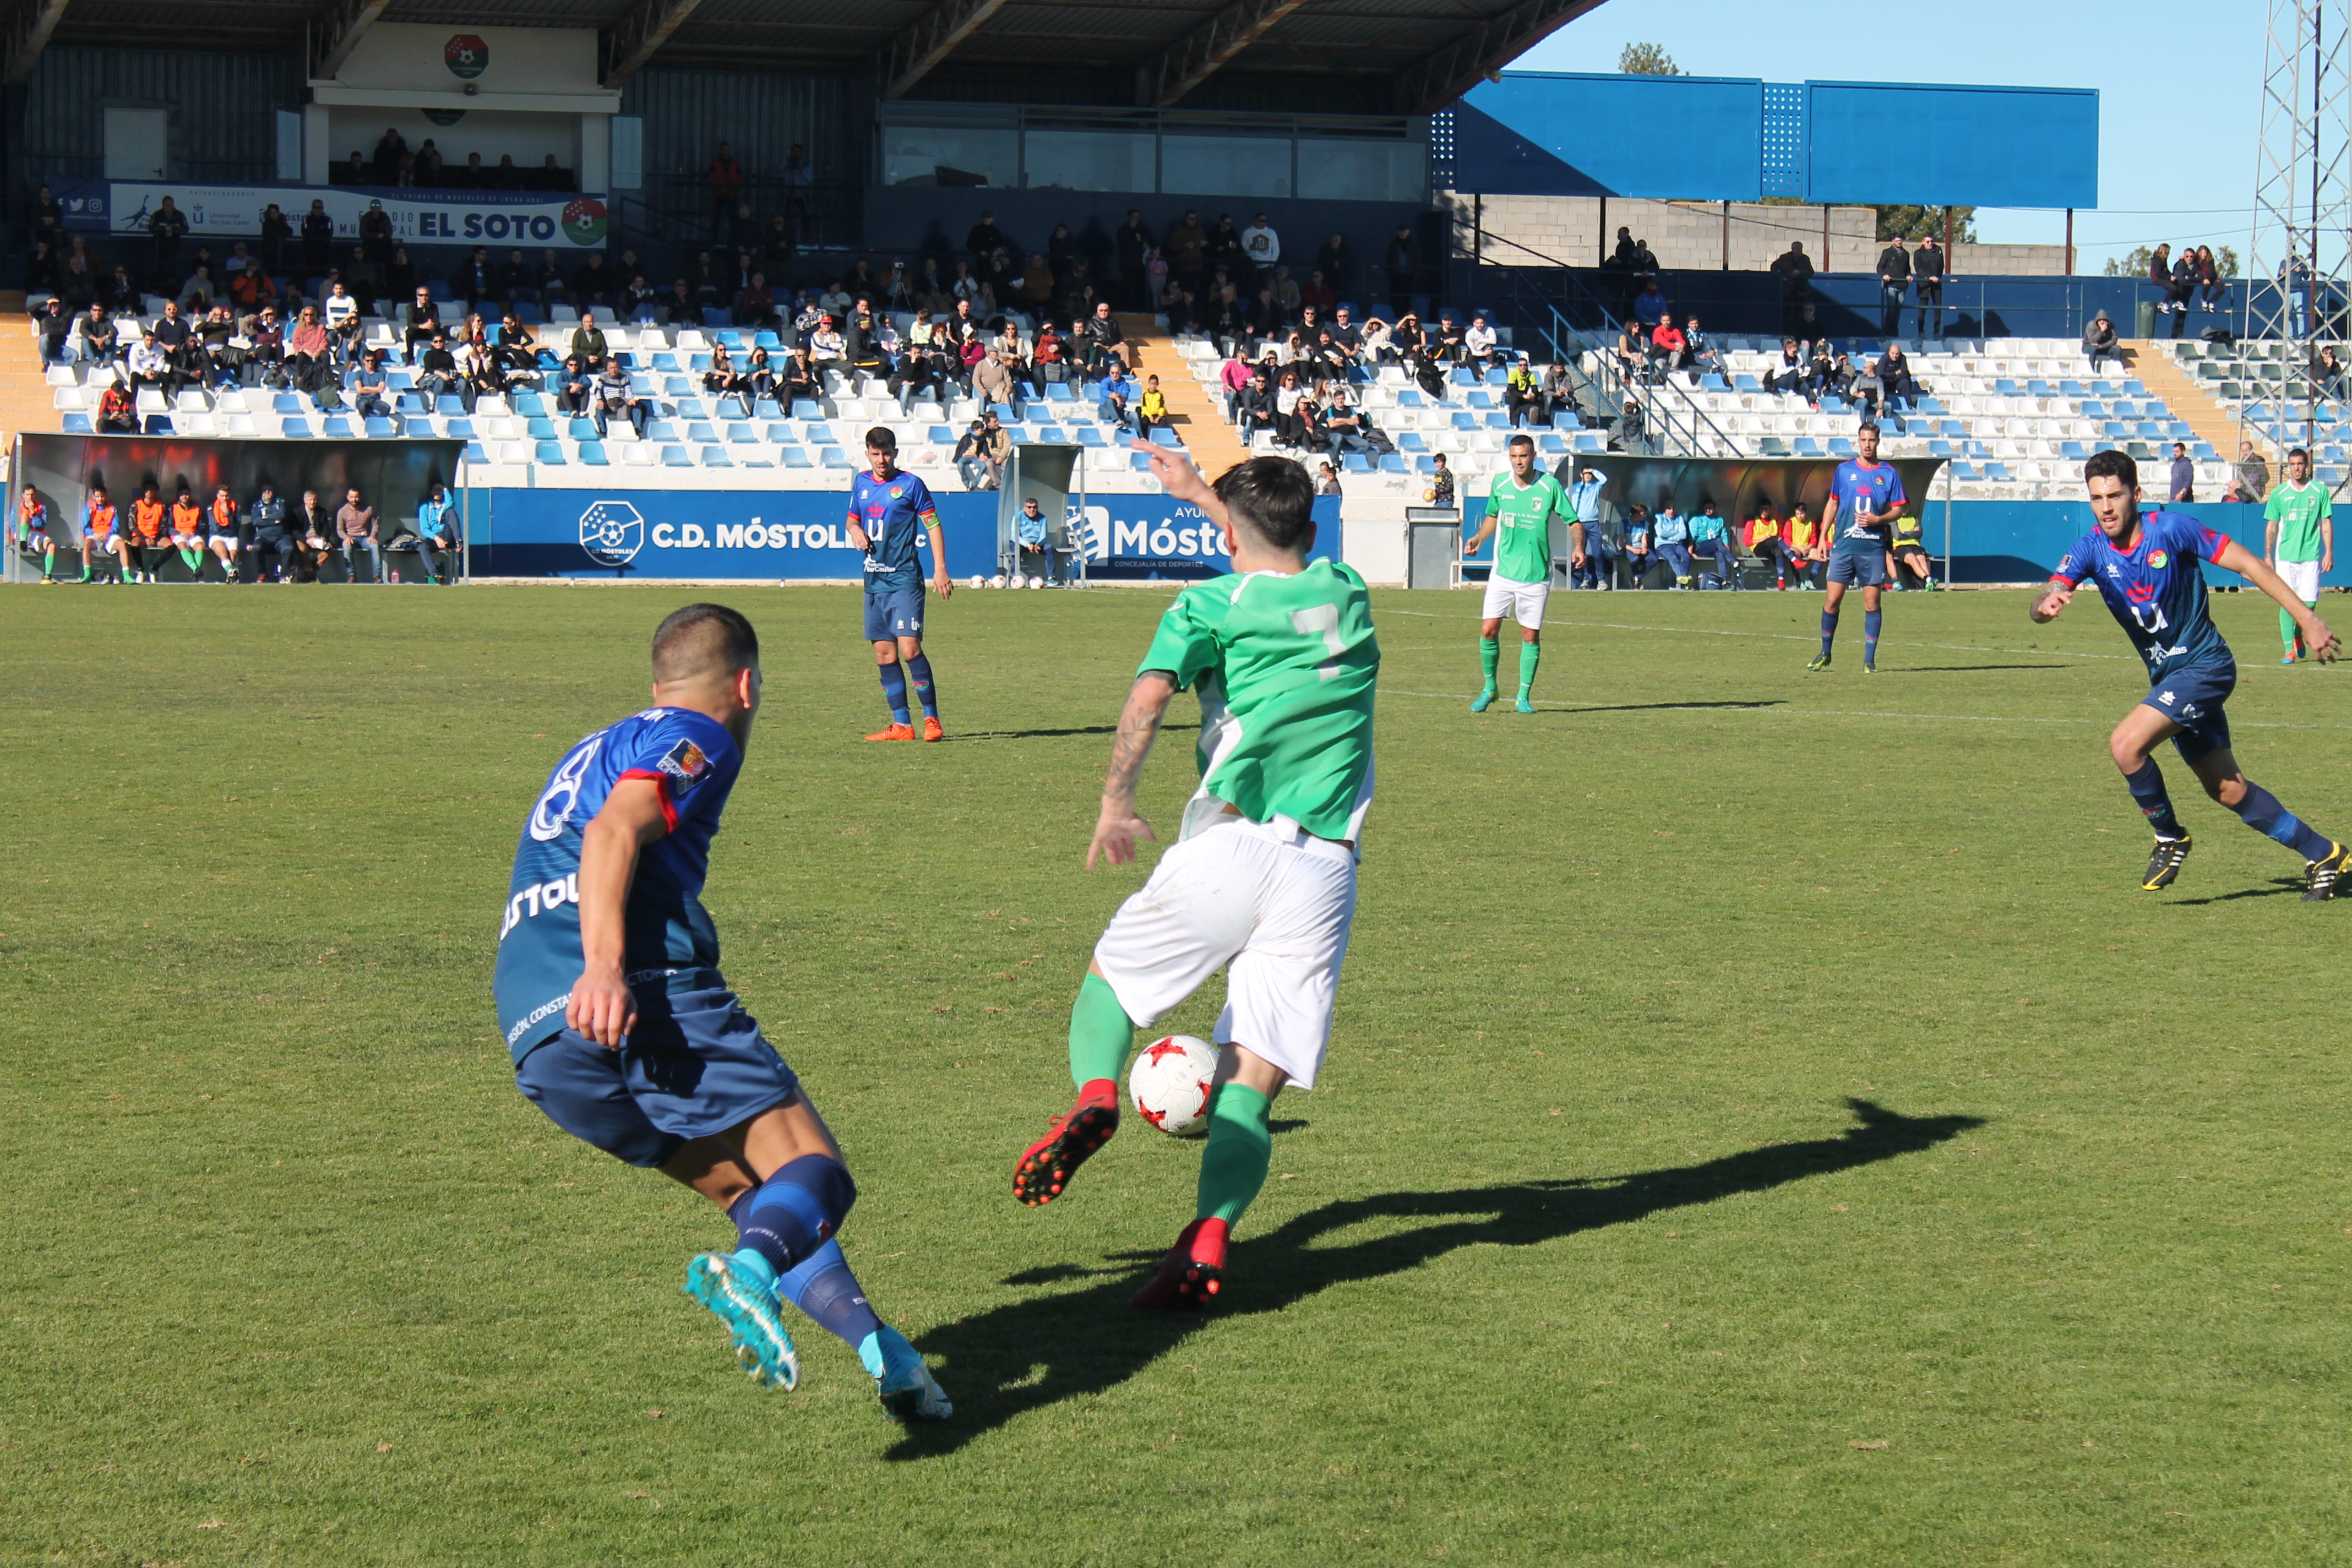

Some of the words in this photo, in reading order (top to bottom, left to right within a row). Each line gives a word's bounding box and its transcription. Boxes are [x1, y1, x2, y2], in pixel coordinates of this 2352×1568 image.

[420, 213, 456, 237] EL
[463, 213, 555, 241] SOTO
[651, 522, 711, 548] C.D.
[1289, 602, 1347, 683] 7
[529, 737, 604, 842] 8
[530, 993, 572, 1024] CONSTA
